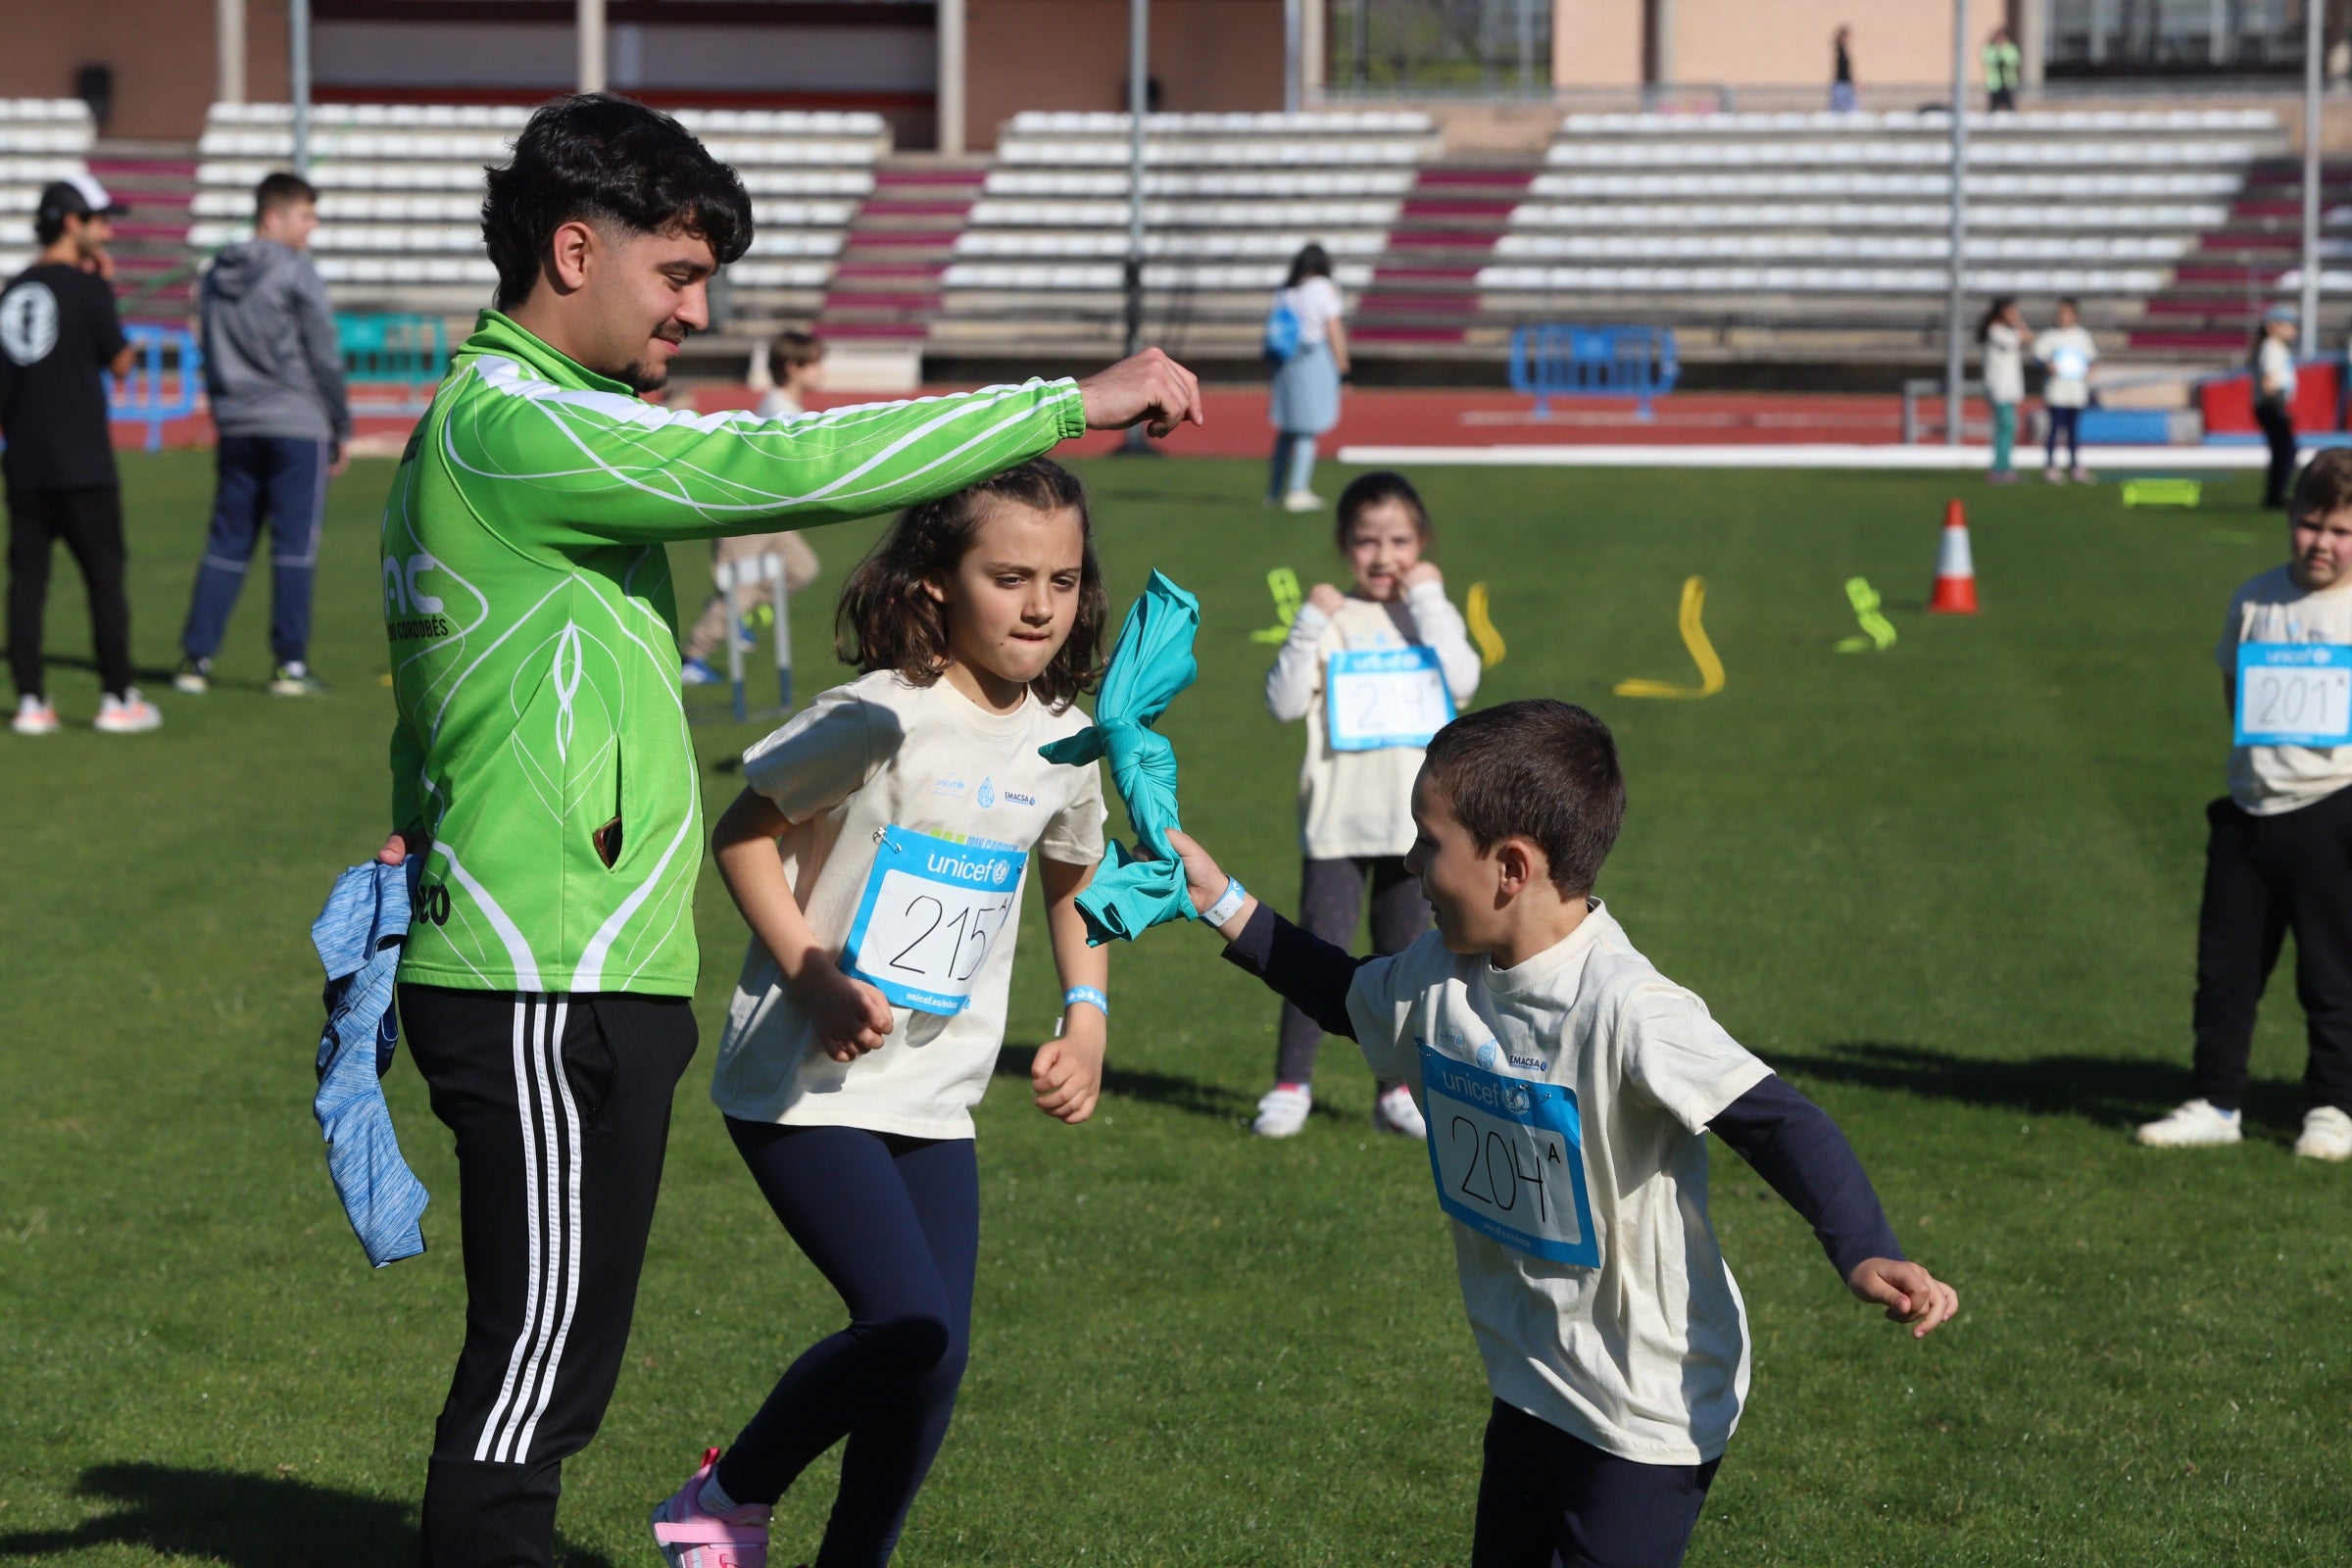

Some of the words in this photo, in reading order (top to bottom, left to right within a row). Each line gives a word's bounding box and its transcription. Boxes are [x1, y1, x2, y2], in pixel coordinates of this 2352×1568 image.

[397, 614, 449, 640] CORDOBÉS
[2258, 674, 2345, 725] 201
[1004, 791, 1029, 803] EMACSA
[927, 854, 996, 882] unicef
[1509, 1054, 1540, 1068] EMACSA
[1442, 1070, 1500, 1108] unicef
